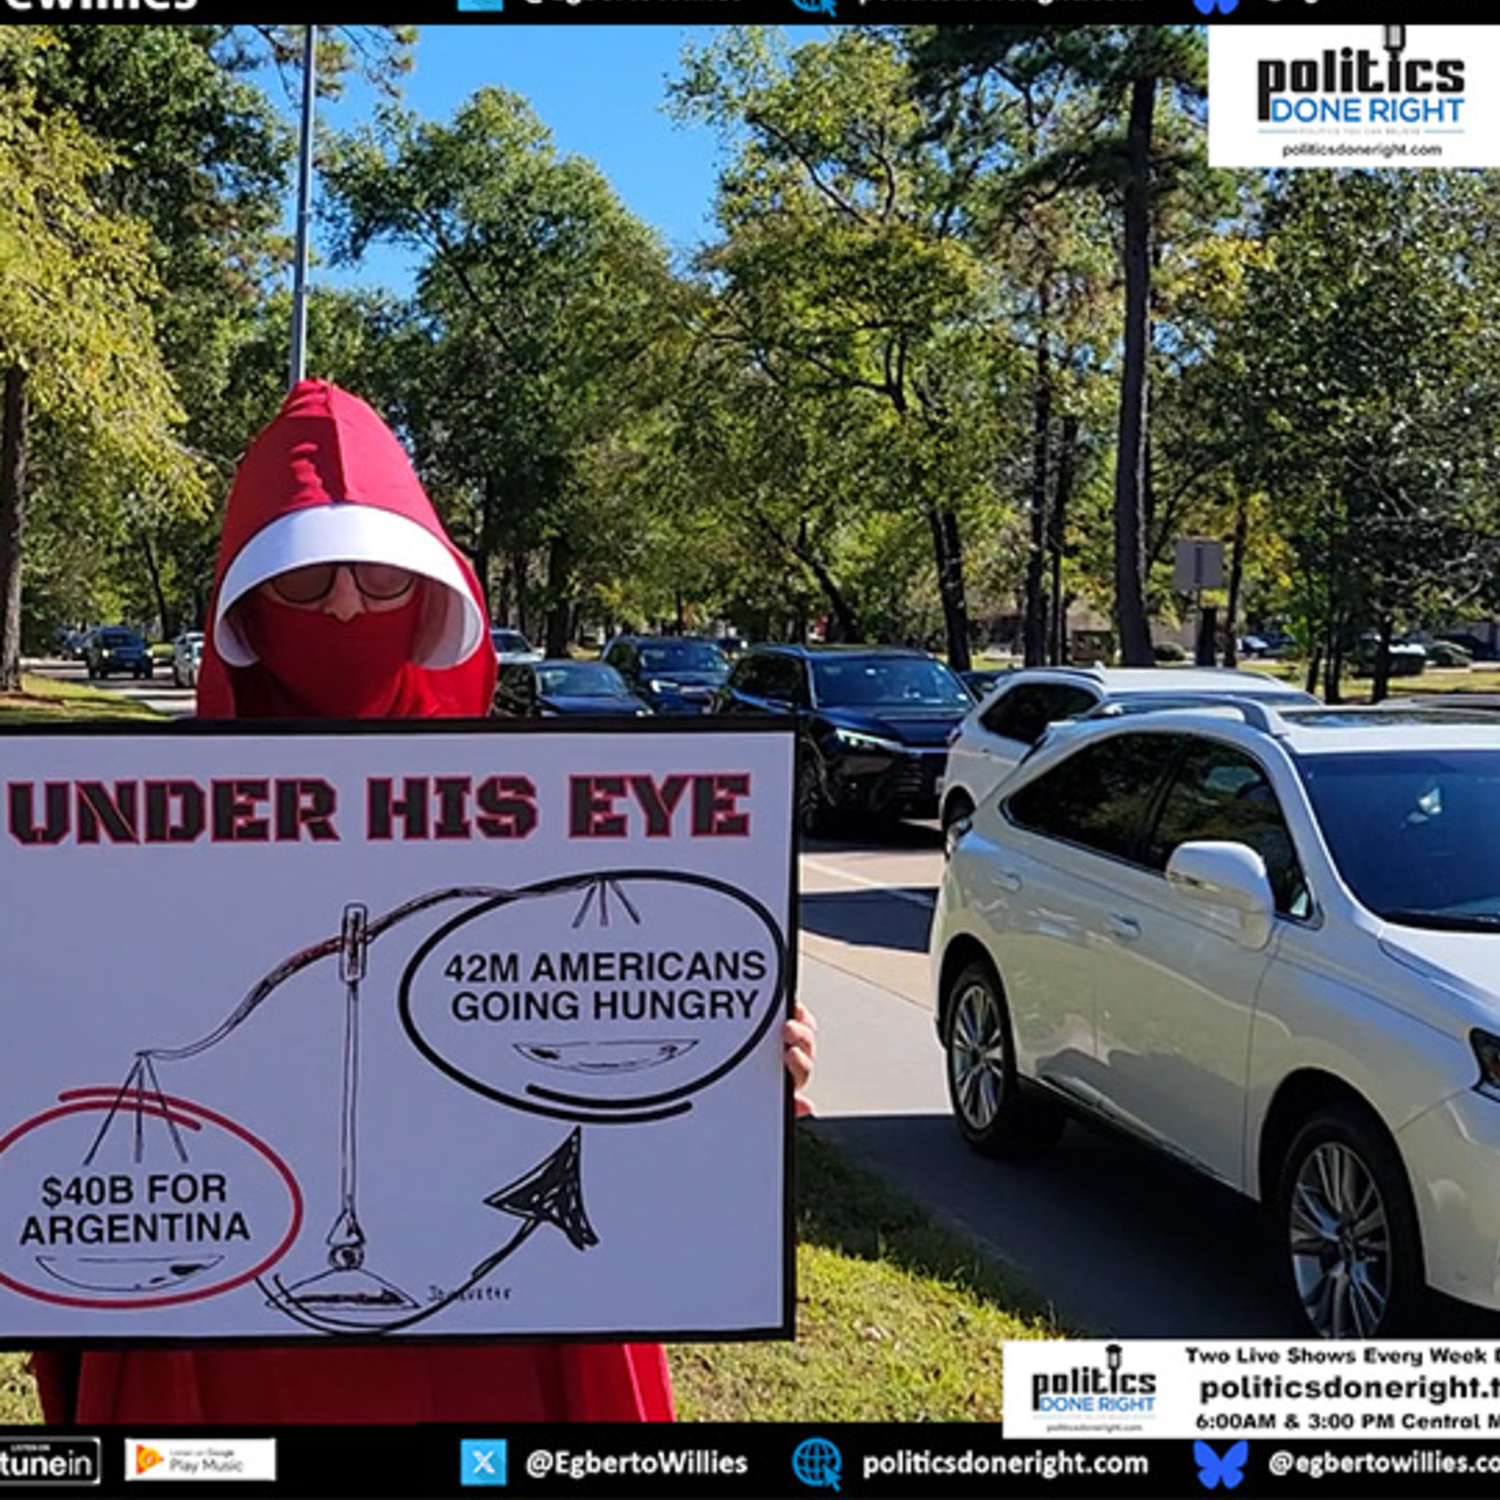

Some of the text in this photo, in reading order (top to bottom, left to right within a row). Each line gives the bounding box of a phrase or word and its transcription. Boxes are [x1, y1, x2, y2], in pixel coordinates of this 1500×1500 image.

[8, 772, 752, 845] UNDER HIS EYE
[444, 951, 768, 985] 42M AMERICANS
[452, 988, 761, 1023] GOING HUNGRY
[40, 1171, 228, 1210] $40B FOR
[19, 1211, 251, 1246] ARGENTINA
